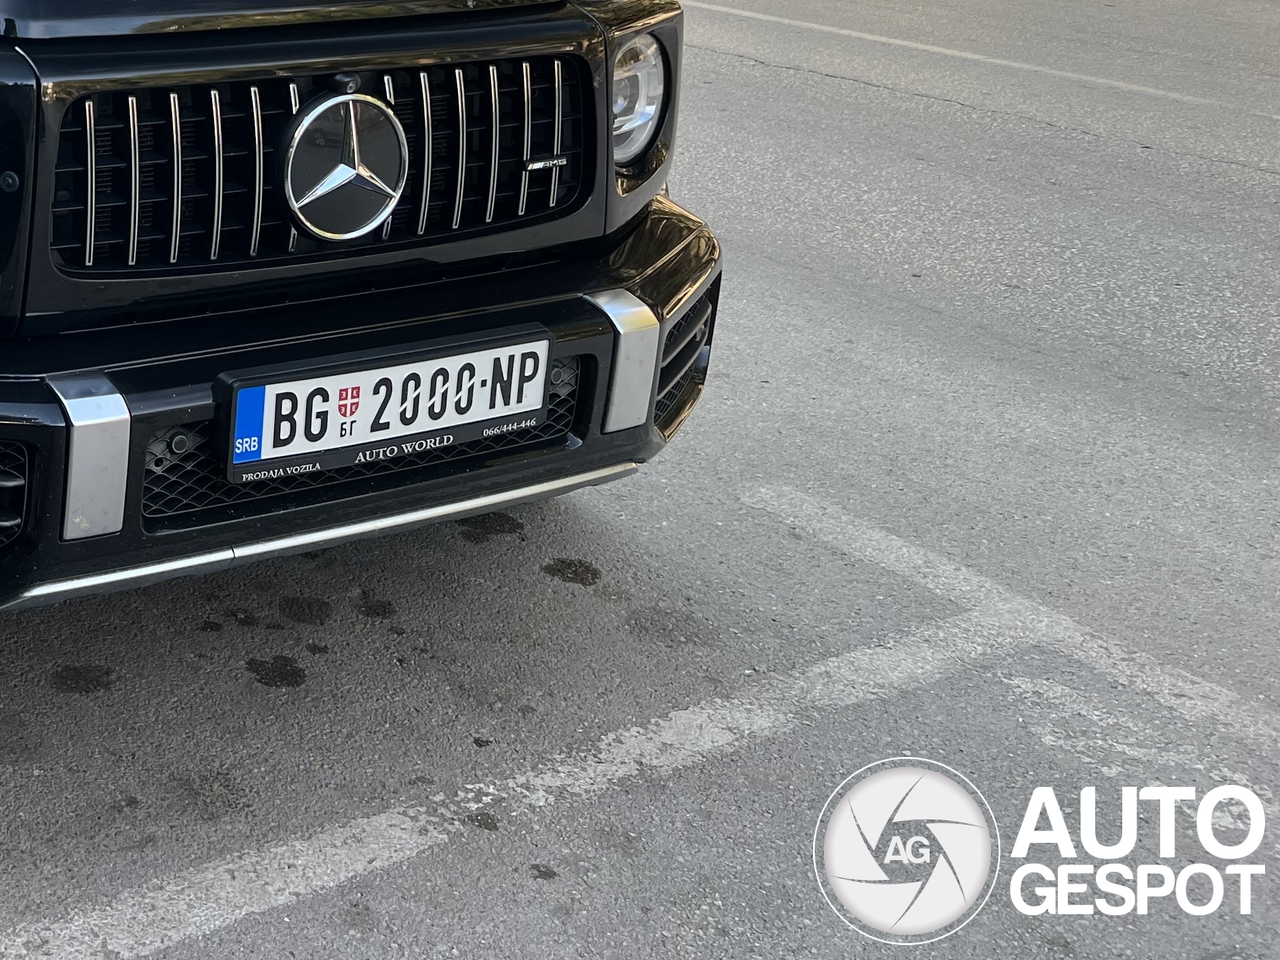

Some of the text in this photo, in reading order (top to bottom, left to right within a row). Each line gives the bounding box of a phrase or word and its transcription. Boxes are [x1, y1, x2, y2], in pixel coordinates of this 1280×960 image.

[272, 386, 330, 449] BG
[482, 417, 537, 438] 066/444-446
[339, 420, 357, 438] БГ
[235, 436, 259, 454] SRB
[354, 434, 454, 464] AUTO WORLD
[241, 462, 322, 483] PRODAJA VOZILA
